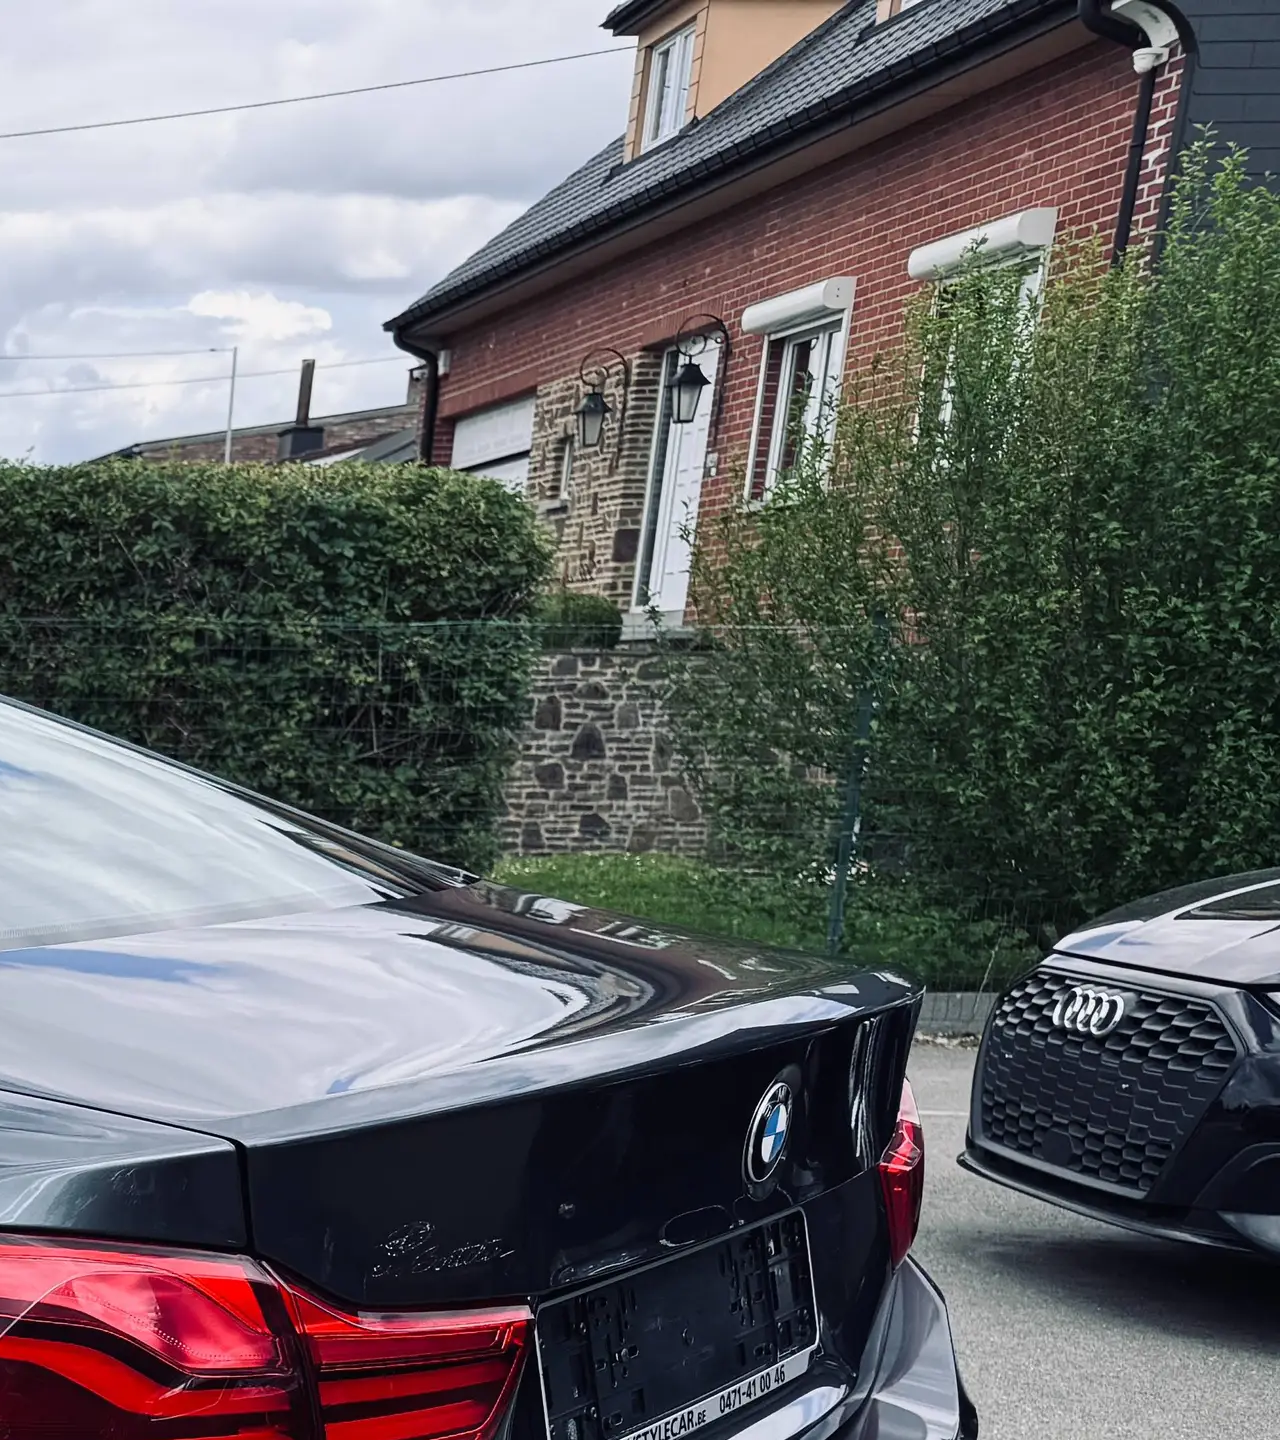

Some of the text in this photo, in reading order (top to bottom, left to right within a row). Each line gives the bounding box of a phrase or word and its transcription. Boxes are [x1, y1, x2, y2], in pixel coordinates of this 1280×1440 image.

[719, 1382, 757, 1414] 0471-41
[760, 1376, 771, 1394] 00
[774, 1364, 786, 1386] 46
